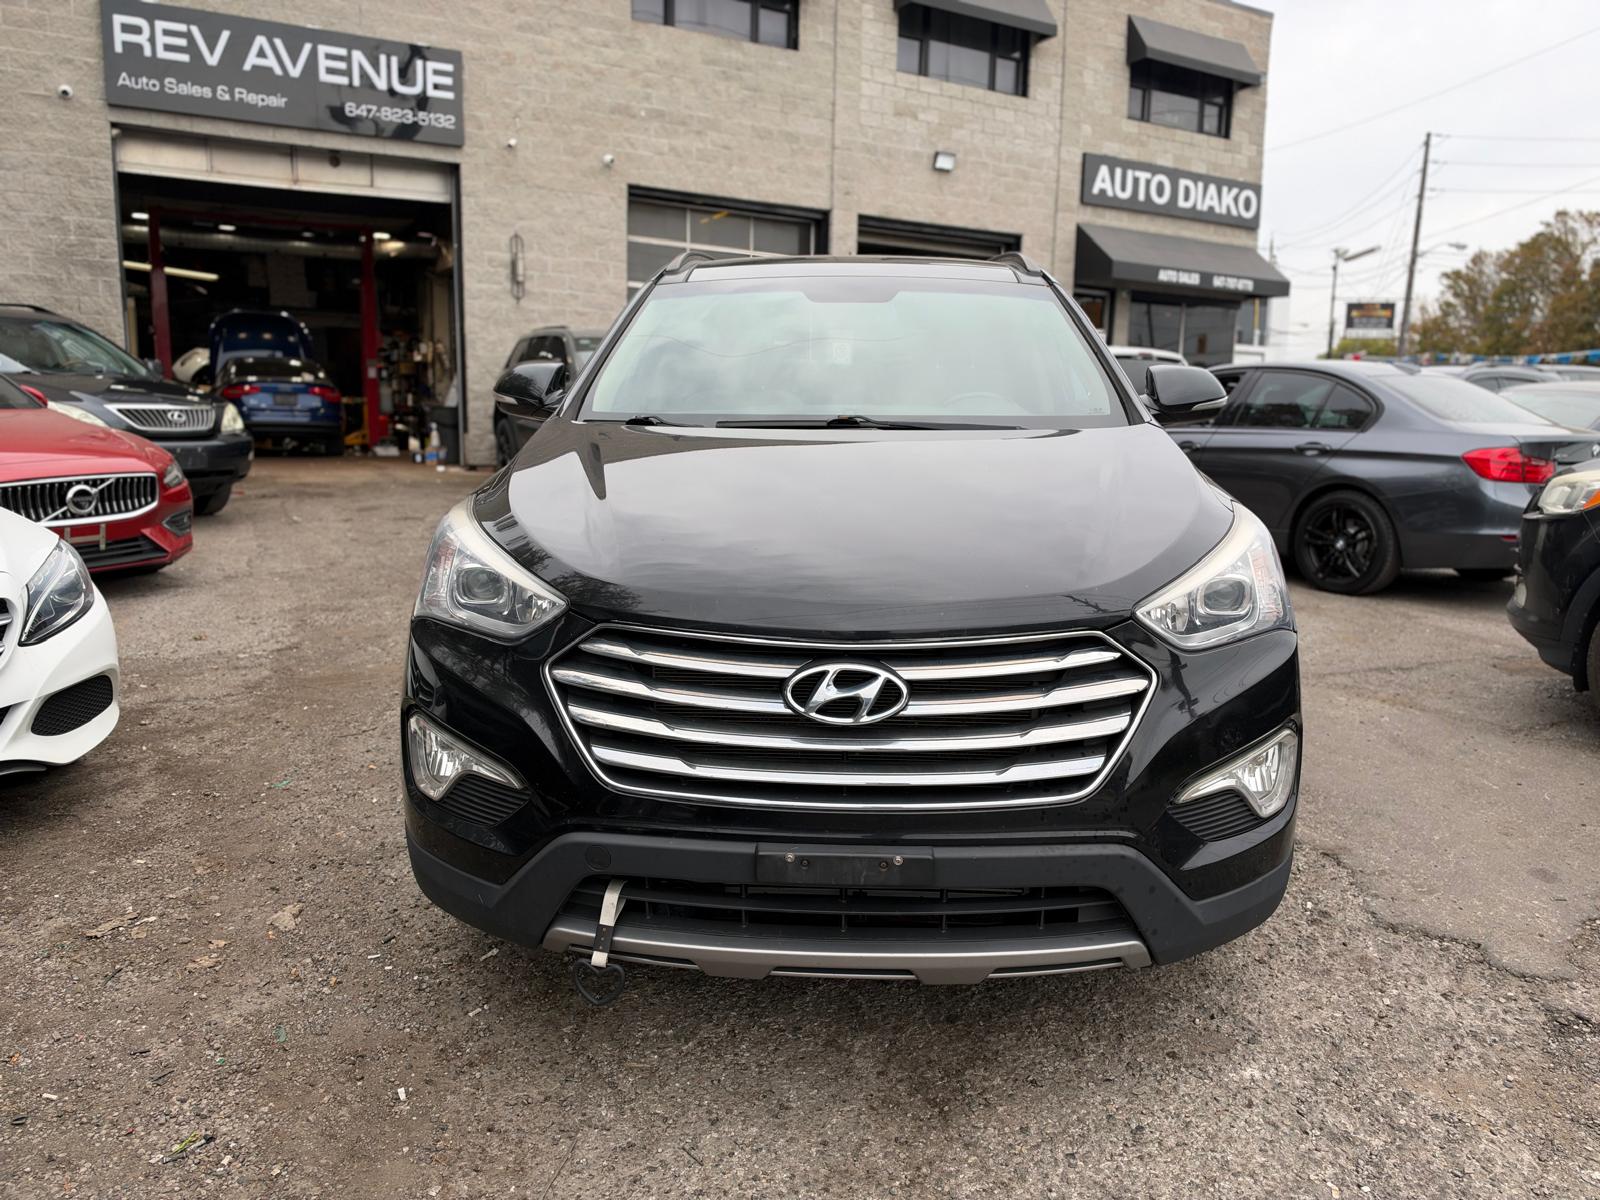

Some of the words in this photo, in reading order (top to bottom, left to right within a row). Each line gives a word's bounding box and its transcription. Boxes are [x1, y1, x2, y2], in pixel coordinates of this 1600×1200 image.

[112, 14, 230, 66] REV
[243, 35, 455, 99] AVENUE
[117, 71, 160, 92] Auto
[164, 77, 213, 99] Sales
[216, 84, 231, 102] &
[234, 88, 288, 109] Repair
[344, 102, 455, 129] 647-823-5132
[1092, 165, 1171, 205] AUTO
[1178, 179, 1257, 218] DIAKO
[1158, 269, 1177, 282] AUTO
